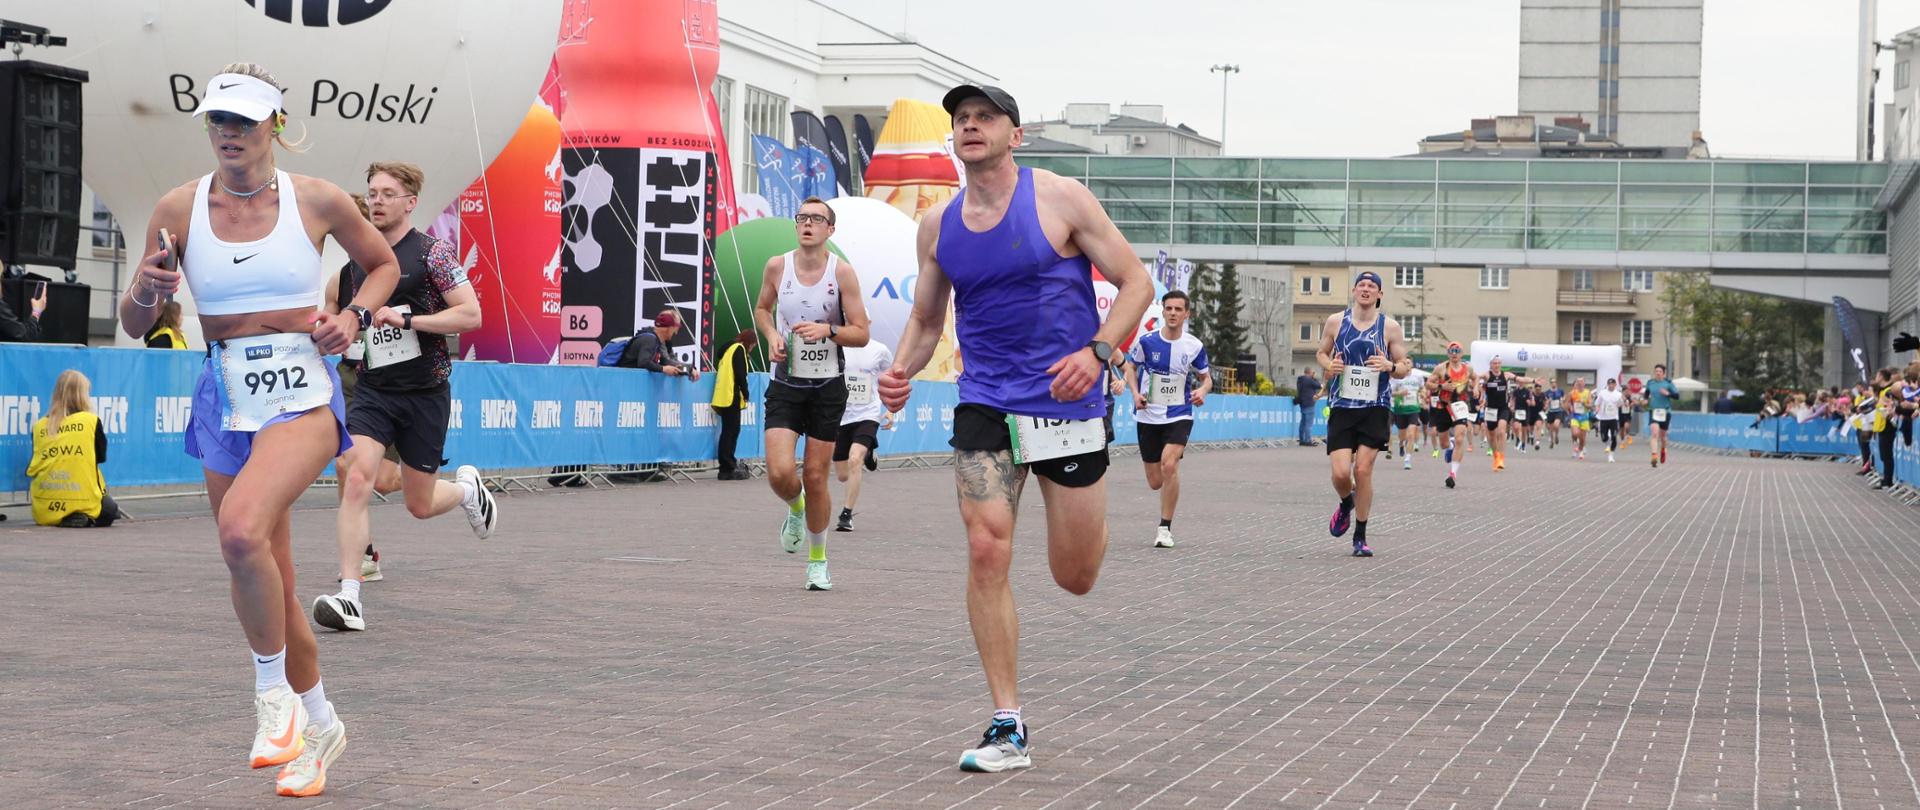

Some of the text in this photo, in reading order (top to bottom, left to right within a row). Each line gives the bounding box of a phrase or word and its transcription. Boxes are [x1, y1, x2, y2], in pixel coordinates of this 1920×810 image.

[310, 79, 438, 125] Polski
[647, 137, 667, 145] BEZ
[569, 314, 589, 330] B6
[372, 327, 402, 346] 6158
[256, 348, 271, 357] PKO
[563, 352, 595, 360] BIOTYNA
[800, 349, 829, 361] 2057
[244, 365, 308, 395] 9912
[1350, 378, 1370, 387] 1018
[1160, 386, 1177, 394] 6161
[264, 394, 295, 407] Joanna
[40, 423, 84, 438] STWARD
[41, 444, 84, 461] SOWA
[48, 501, 67, 512] 494
